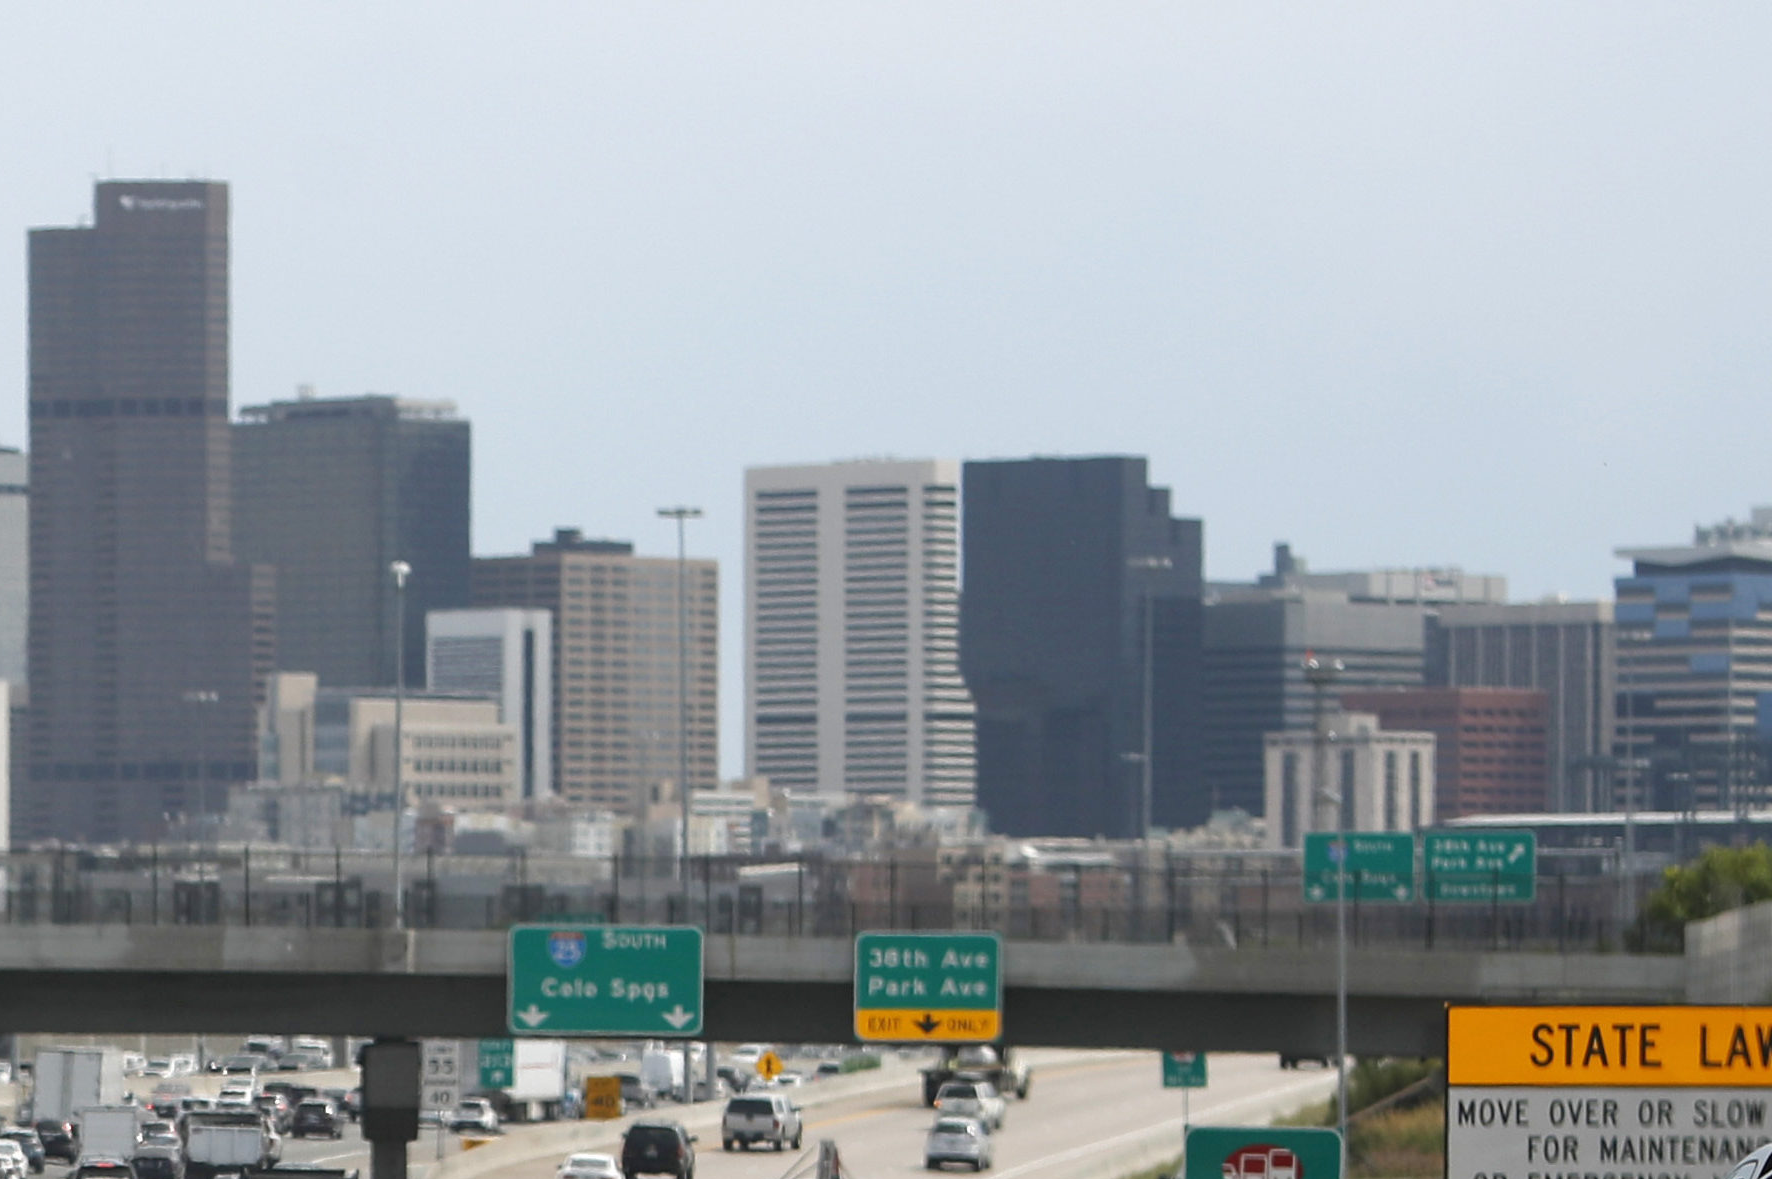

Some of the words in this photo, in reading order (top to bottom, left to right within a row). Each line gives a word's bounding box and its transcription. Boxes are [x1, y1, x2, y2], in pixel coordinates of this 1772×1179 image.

[601, 928, 667, 949] SOUTH
[868, 948, 928, 968] 38th
[940, 948, 989, 968] Ave
[541, 977, 598, 998] Colo
[867, 976, 927, 996] Park
[939, 977, 988, 996] Ave
[867, 1016, 900, 1032] EXIT
[946, 1017, 989, 1033] ONLY
[1530, 1023, 1662, 1068] STATE
[1457, 1099, 1529, 1126] MOVE
[1549, 1099, 1619, 1127] OVER
[1637, 1099, 1674, 1127] OR
[1692, 1099, 1767, 1127] SLOW
[1528, 1135, 1579, 1163] FOR
